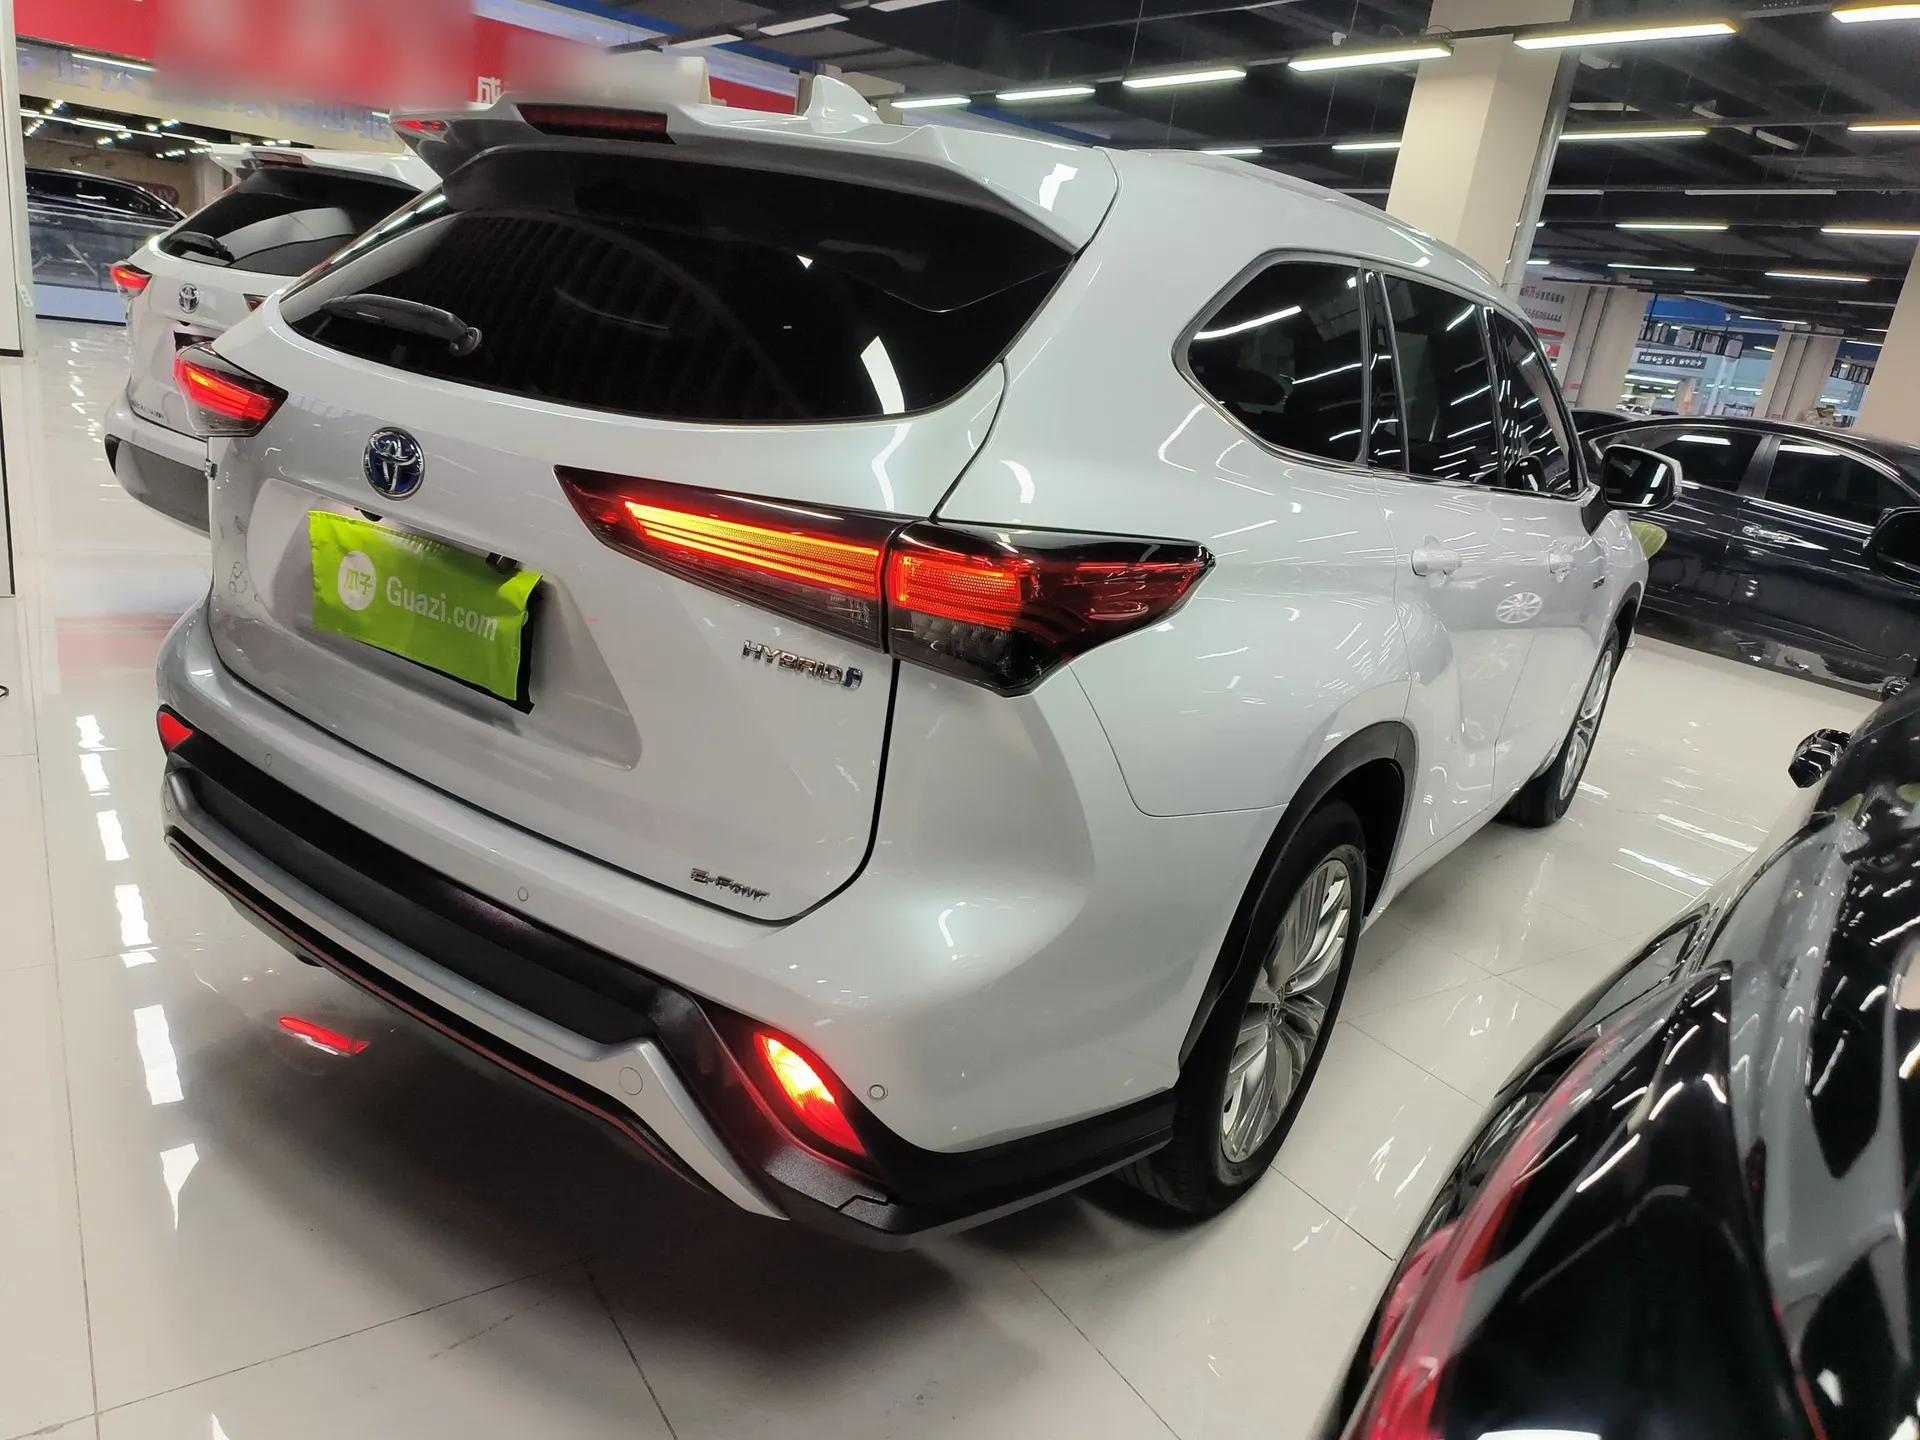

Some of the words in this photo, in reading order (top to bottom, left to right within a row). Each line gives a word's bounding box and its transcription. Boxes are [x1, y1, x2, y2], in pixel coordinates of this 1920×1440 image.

[344, 568, 374, 596] 瓜子
[386, 575, 498, 641] Guazi.com
[742, 640, 844, 686] HYBRID
